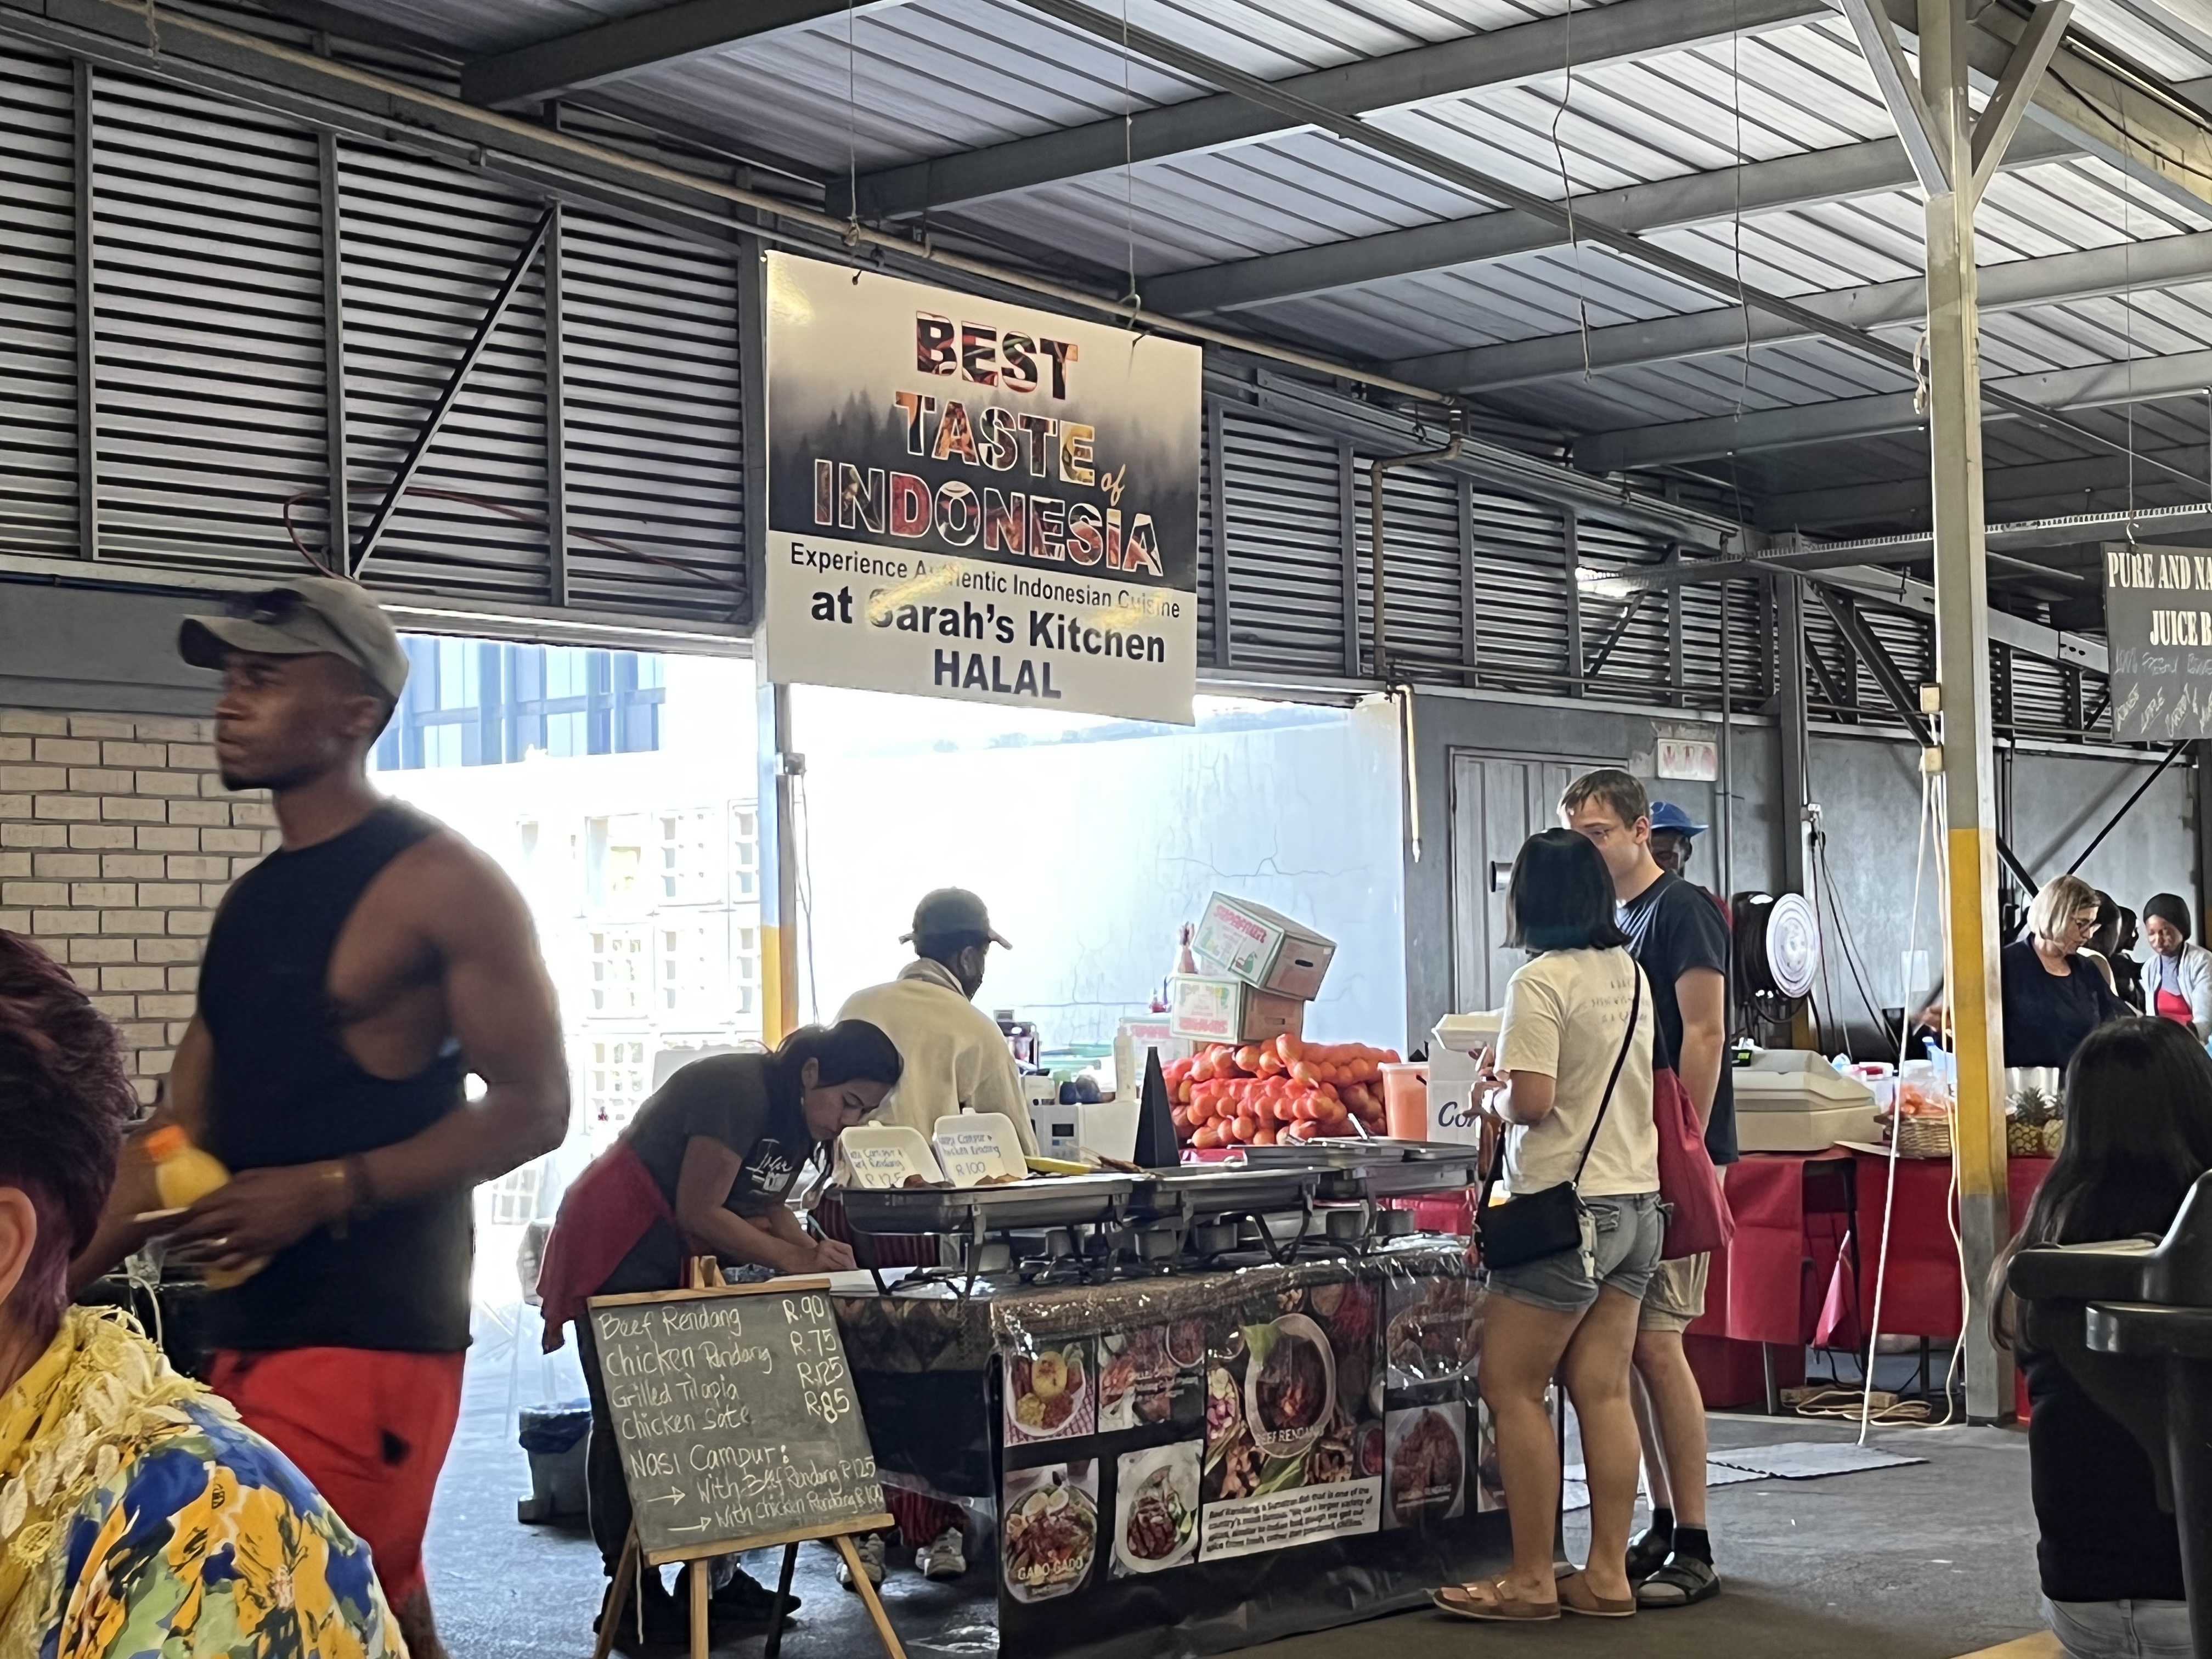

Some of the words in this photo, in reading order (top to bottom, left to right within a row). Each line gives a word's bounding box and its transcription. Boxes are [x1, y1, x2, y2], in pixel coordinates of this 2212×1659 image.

[916, 311, 1078, 400] BEST
[895, 392, 1096, 486] TASTE
[1101, 464, 1126, 506] of
[814, 458, 1164, 576] INDONESIA
[791, 542, 908, 578] Experience
[1014, 574, 1111, 607] Indonesian
[2107, 552, 2154, 588] PURE
[2158, 554, 2191, 590] AND
[811, 586, 853, 624] at
[1029, 610, 1165, 663] Kitchen
[2150, 610, 2198, 646] JUICE
[934, 648, 1062, 699] HALAL
[598, 1311, 654, 1341] Beef
[662, 1304, 742, 1336] Rendang
[612, 1378, 673, 1408] Grilled
[675, 1373, 740, 1408] Tilapia
[702, 1404, 751, 1430] Sate
[715, 1504, 754, 1528] With
